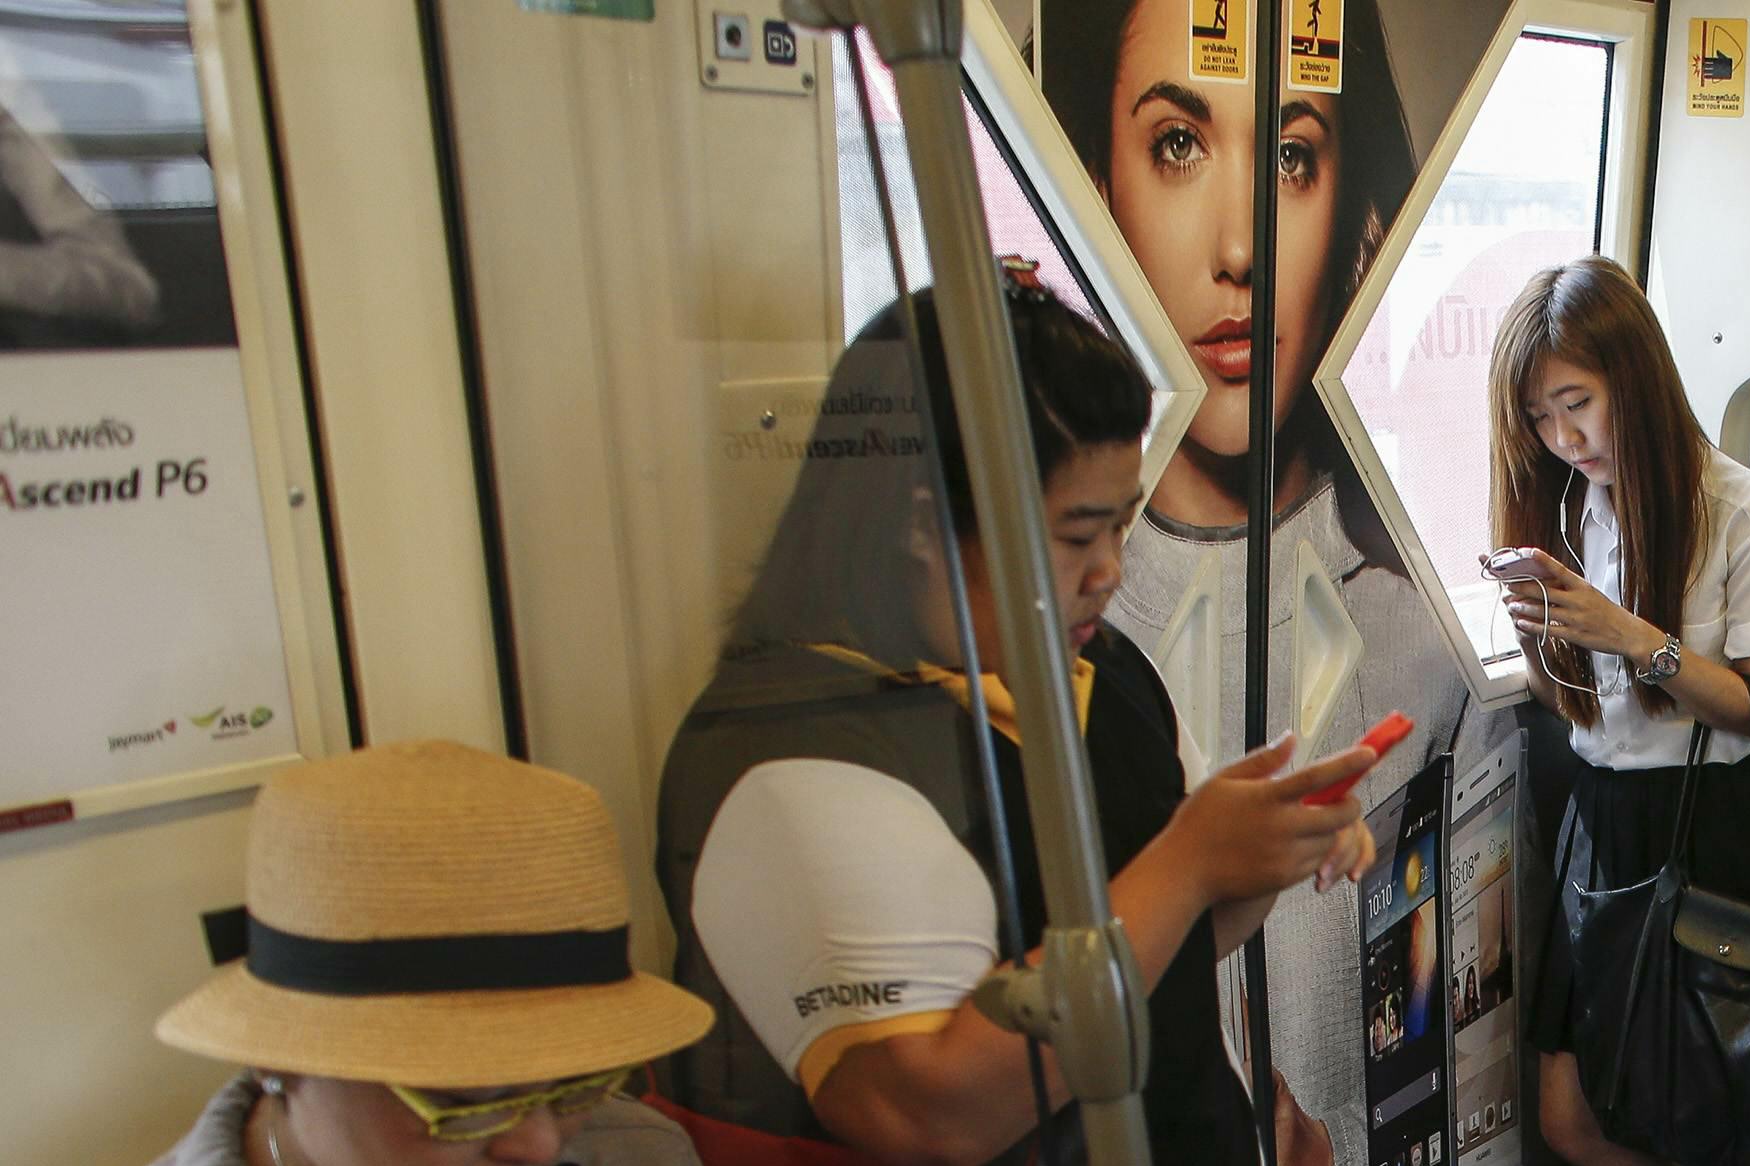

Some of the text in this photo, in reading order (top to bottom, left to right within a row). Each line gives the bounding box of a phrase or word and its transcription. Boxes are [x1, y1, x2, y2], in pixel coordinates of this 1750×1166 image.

[156, 455, 208, 499] P6
[1368, 883, 1393, 920] 10:10
[795, 980, 908, 1018] BETADINE
